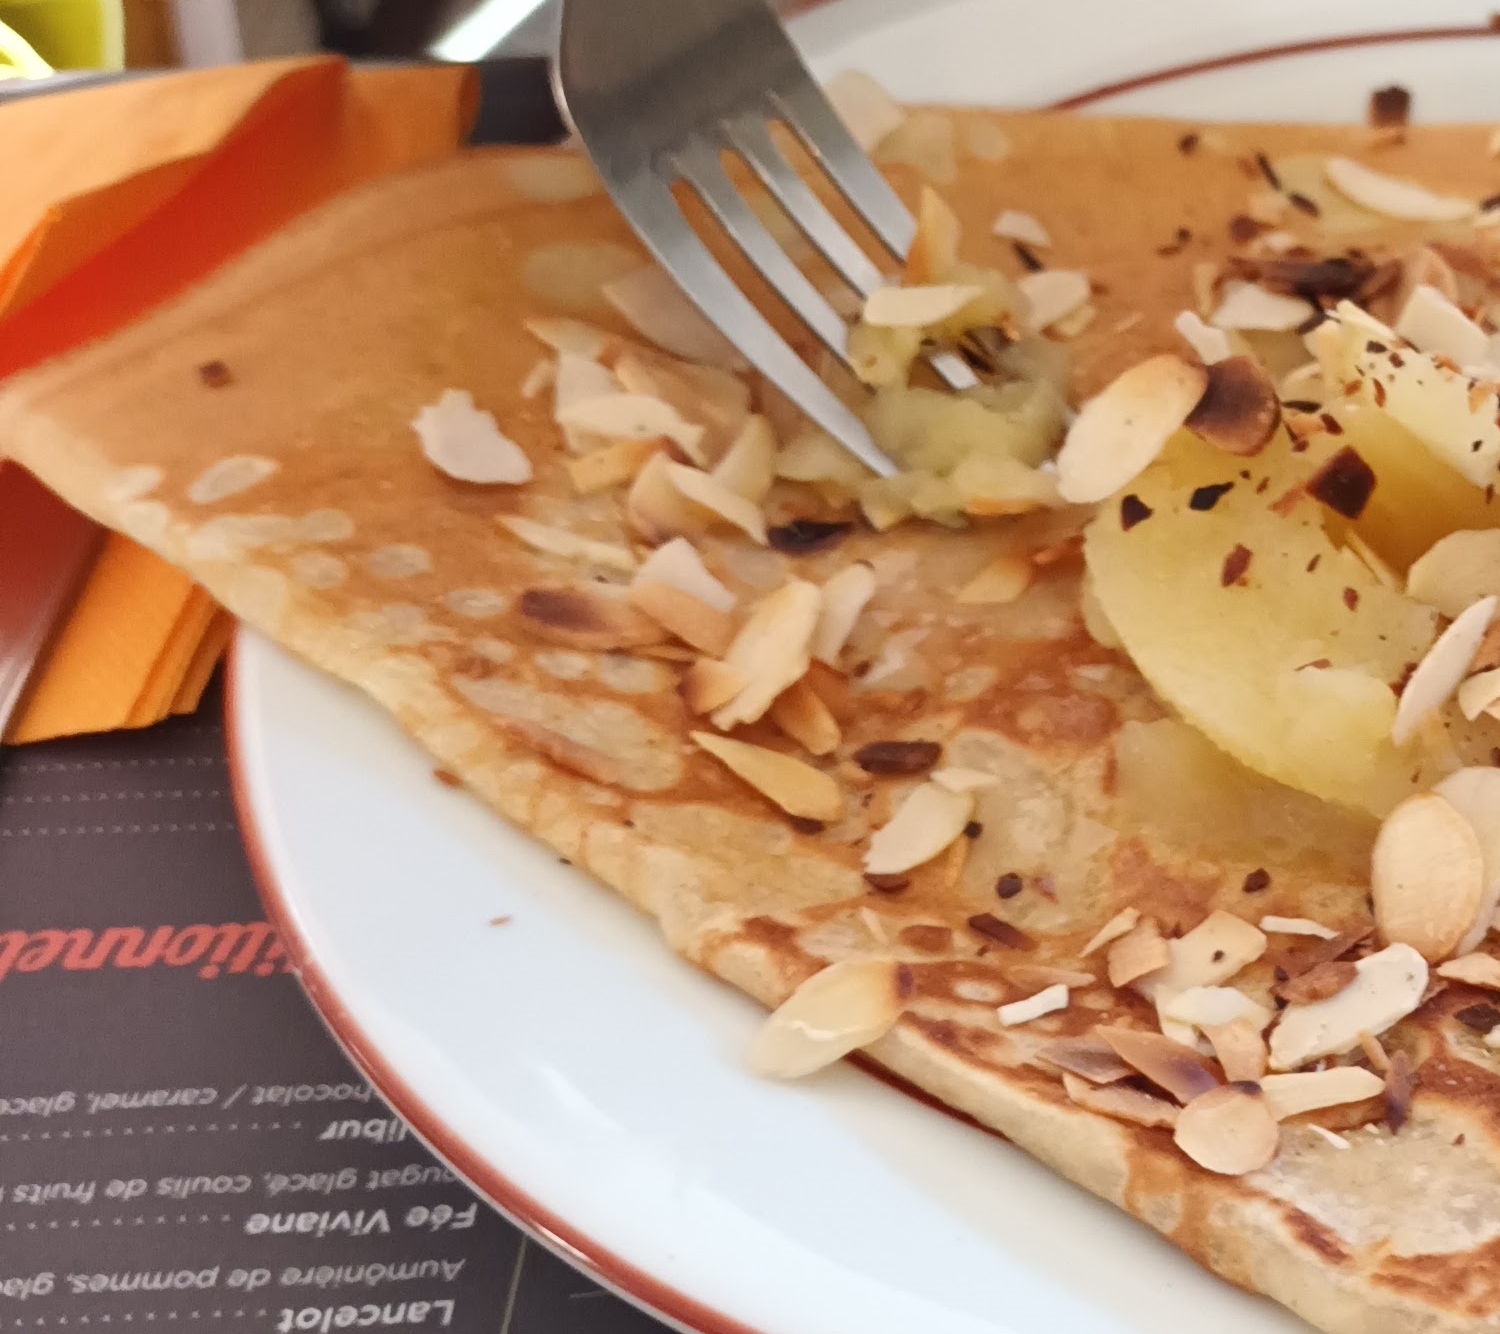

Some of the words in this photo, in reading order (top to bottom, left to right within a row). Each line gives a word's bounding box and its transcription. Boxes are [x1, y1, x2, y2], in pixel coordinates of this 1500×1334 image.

[13, 1179, 97, 1206] fruits
[105, 1178, 148, 1203] de
[157, 1172, 251, 1201] coulis
[244, 1208, 390, 1236] Viviane
[405, 1202, 477, 1234] Fée
[0, 1271, 56, 1302] gla
[66, 1265, 219, 1297] pommes,
[231, 1267, 271, 1295] de
[280, 1258, 466, 1292] Aumônière
[276, 1299, 455, 1334] Lancelot
